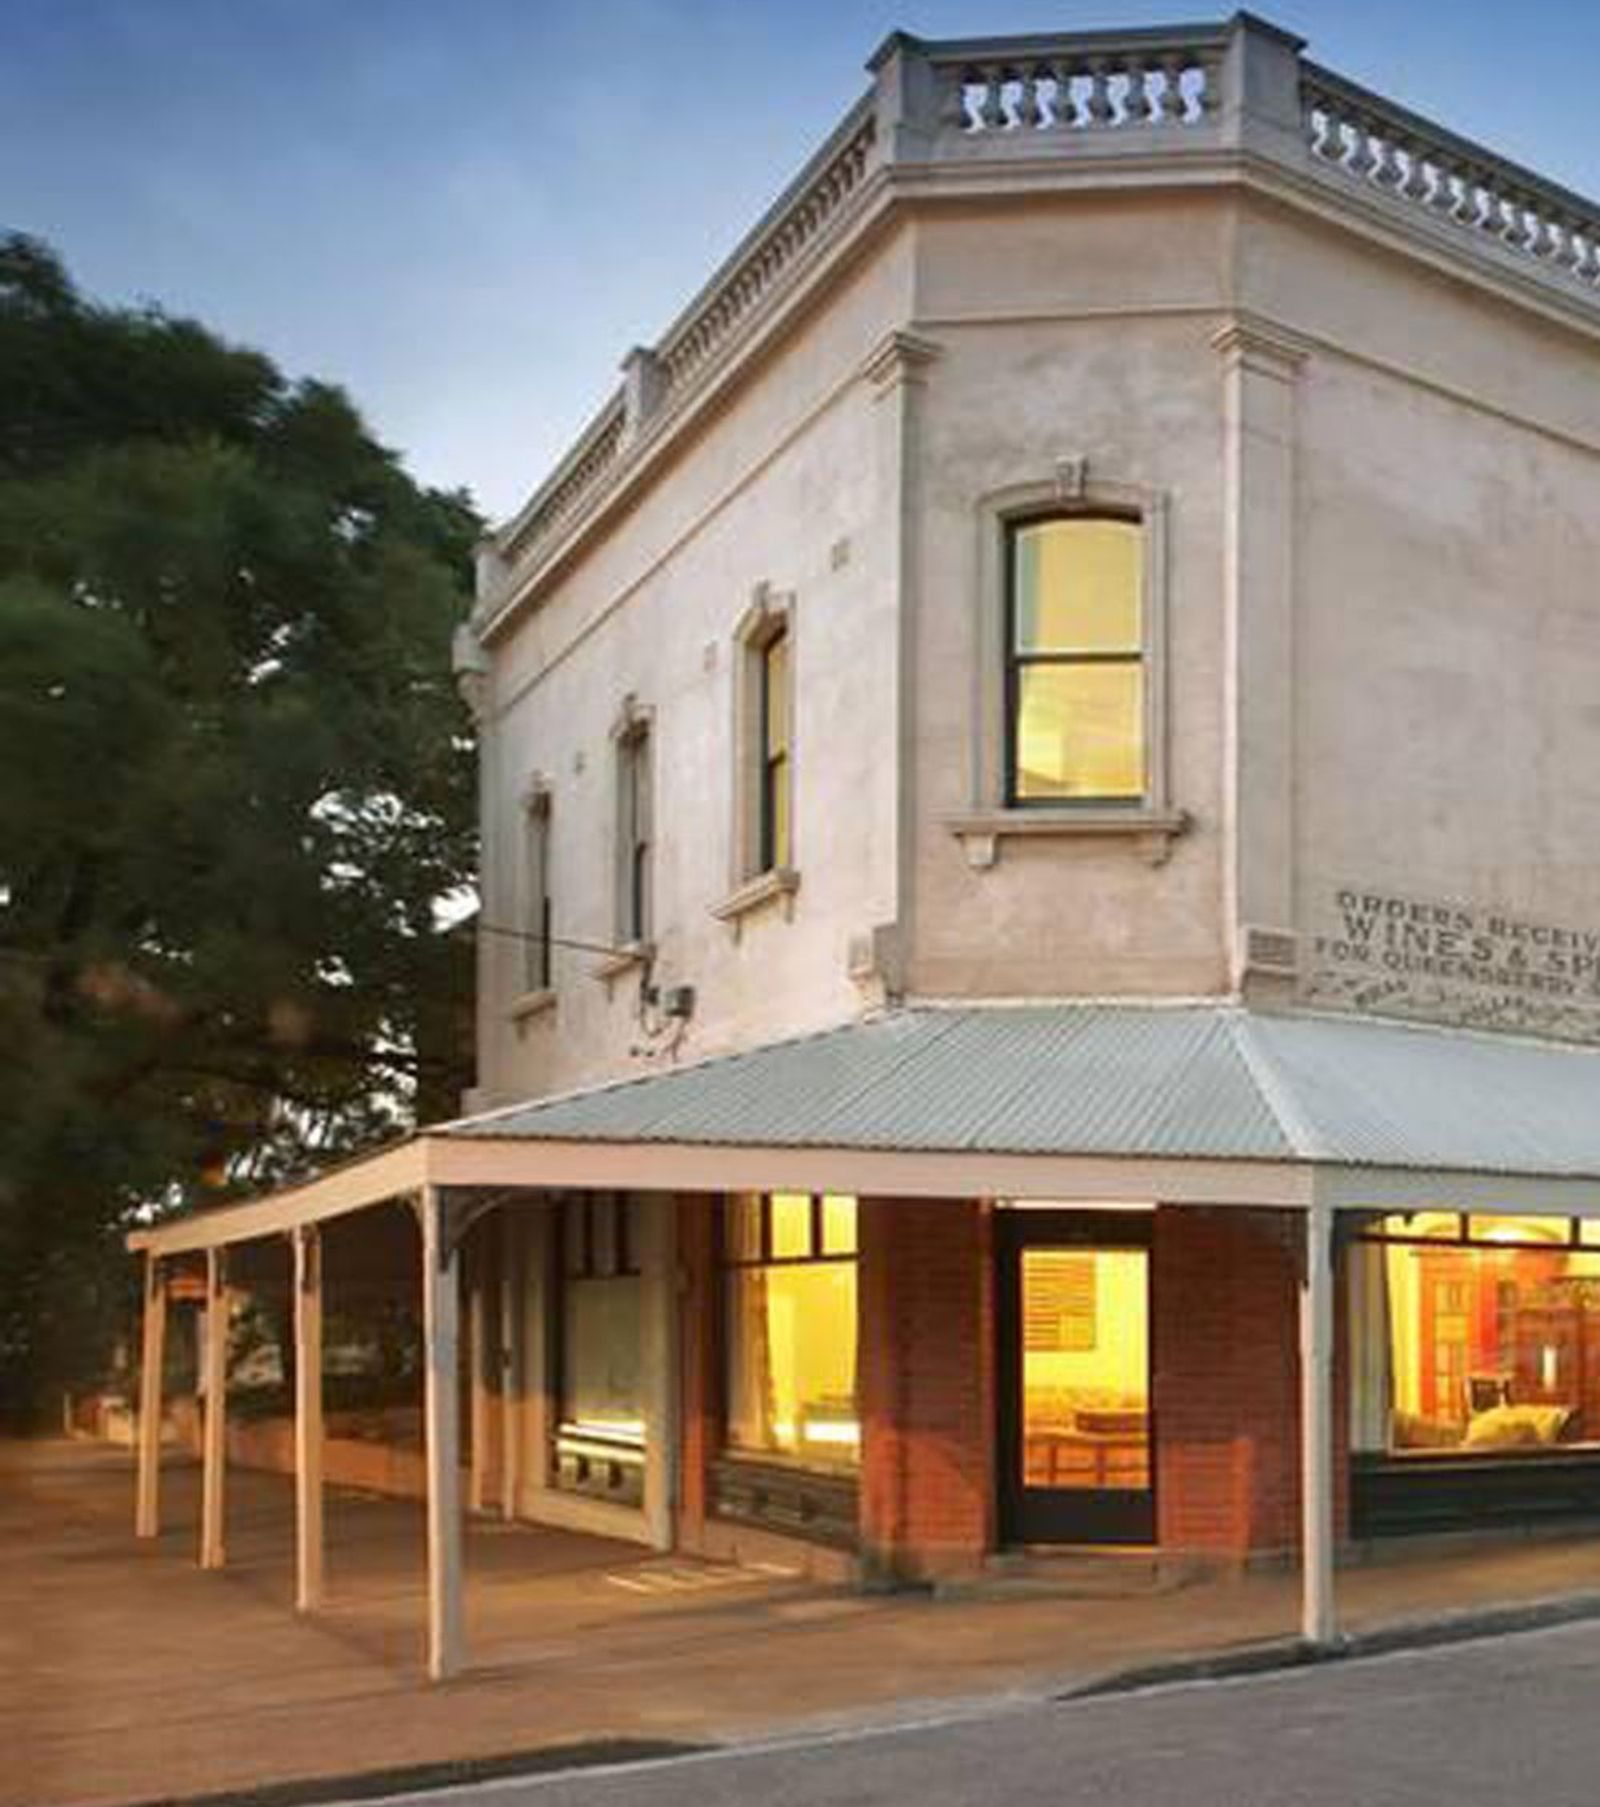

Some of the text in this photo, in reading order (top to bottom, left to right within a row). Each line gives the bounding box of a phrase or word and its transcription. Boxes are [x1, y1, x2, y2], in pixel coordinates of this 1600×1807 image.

[1338, 890, 1474, 930] ORDERS
[1314, 936, 1371, 962] FOR
[1344, 913, 1492, 962] WINES
[1506, 945, 1530, 969] &
